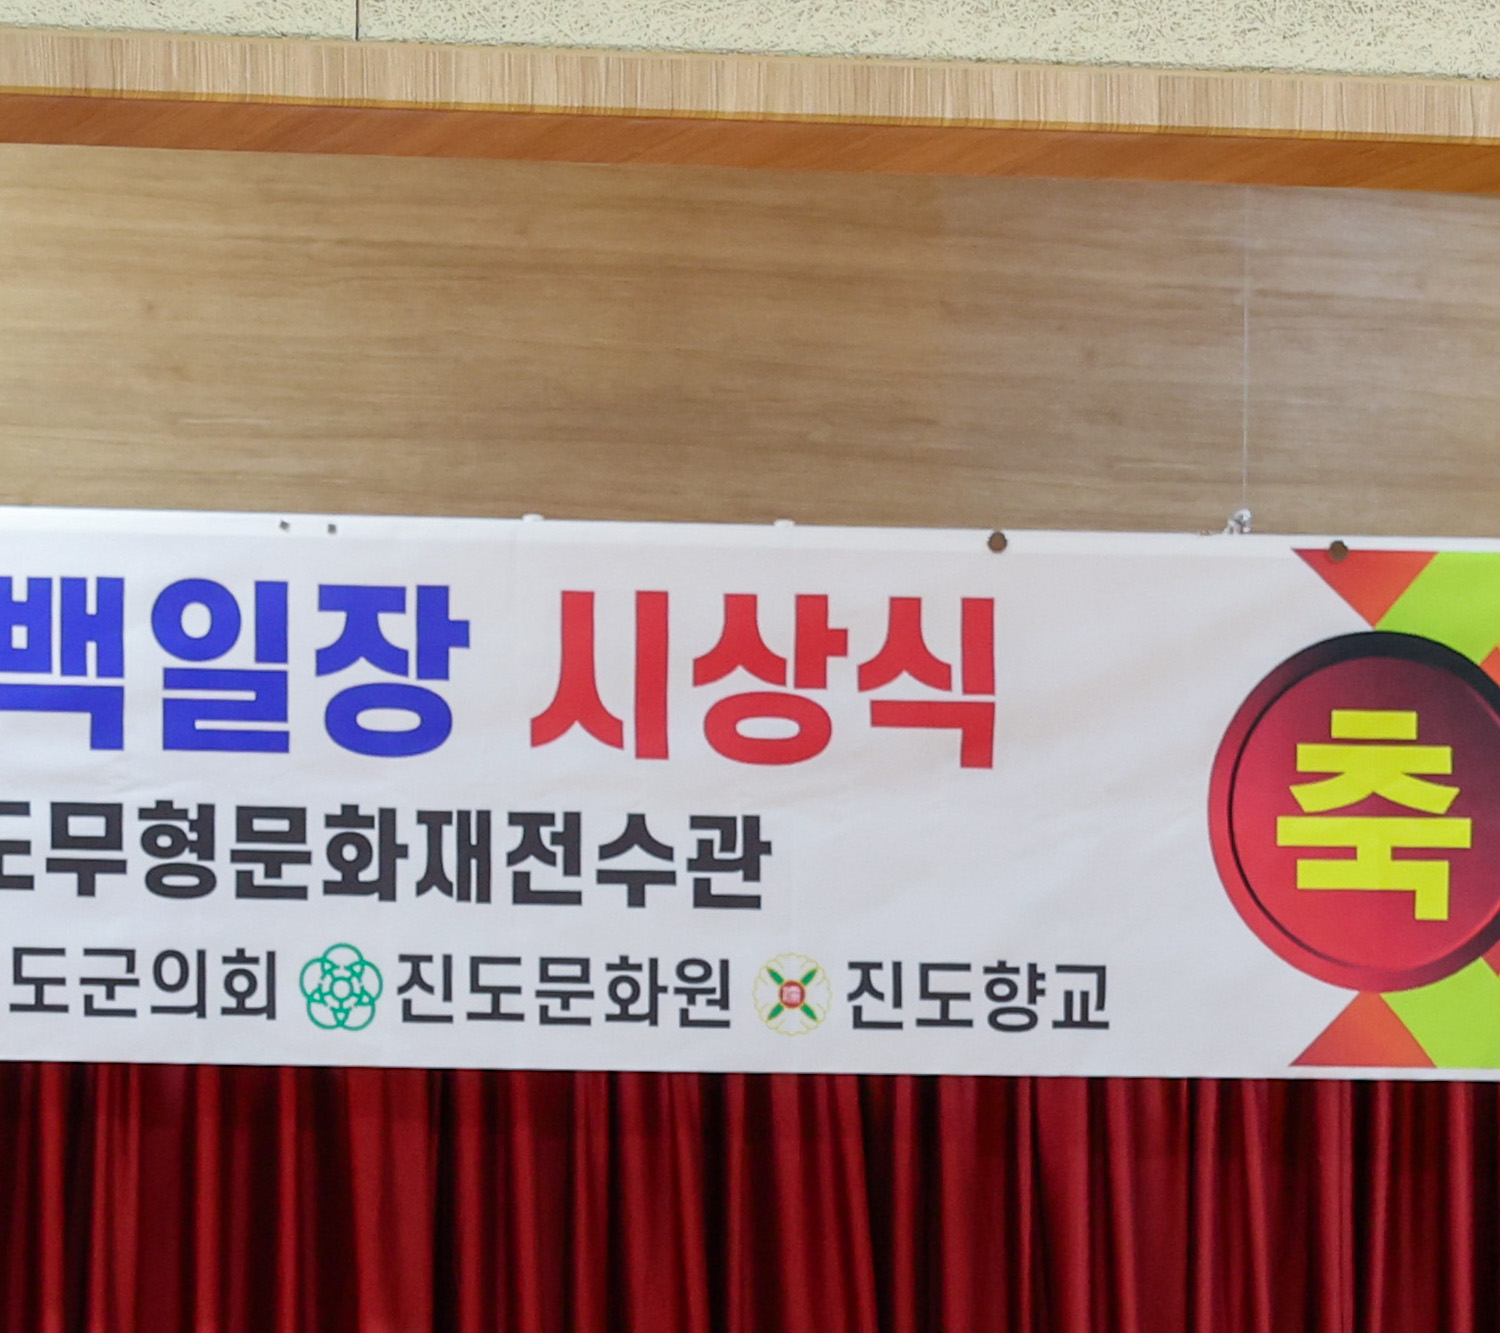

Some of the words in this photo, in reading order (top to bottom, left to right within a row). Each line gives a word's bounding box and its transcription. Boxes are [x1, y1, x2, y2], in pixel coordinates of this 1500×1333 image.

[529, 589, 996, 770] 시상식
[1276, 709, 1472, 922] 축
[396, 953, 731, 1029] 진도문화원
[846, 959, 1110, 1033] 진도향교
